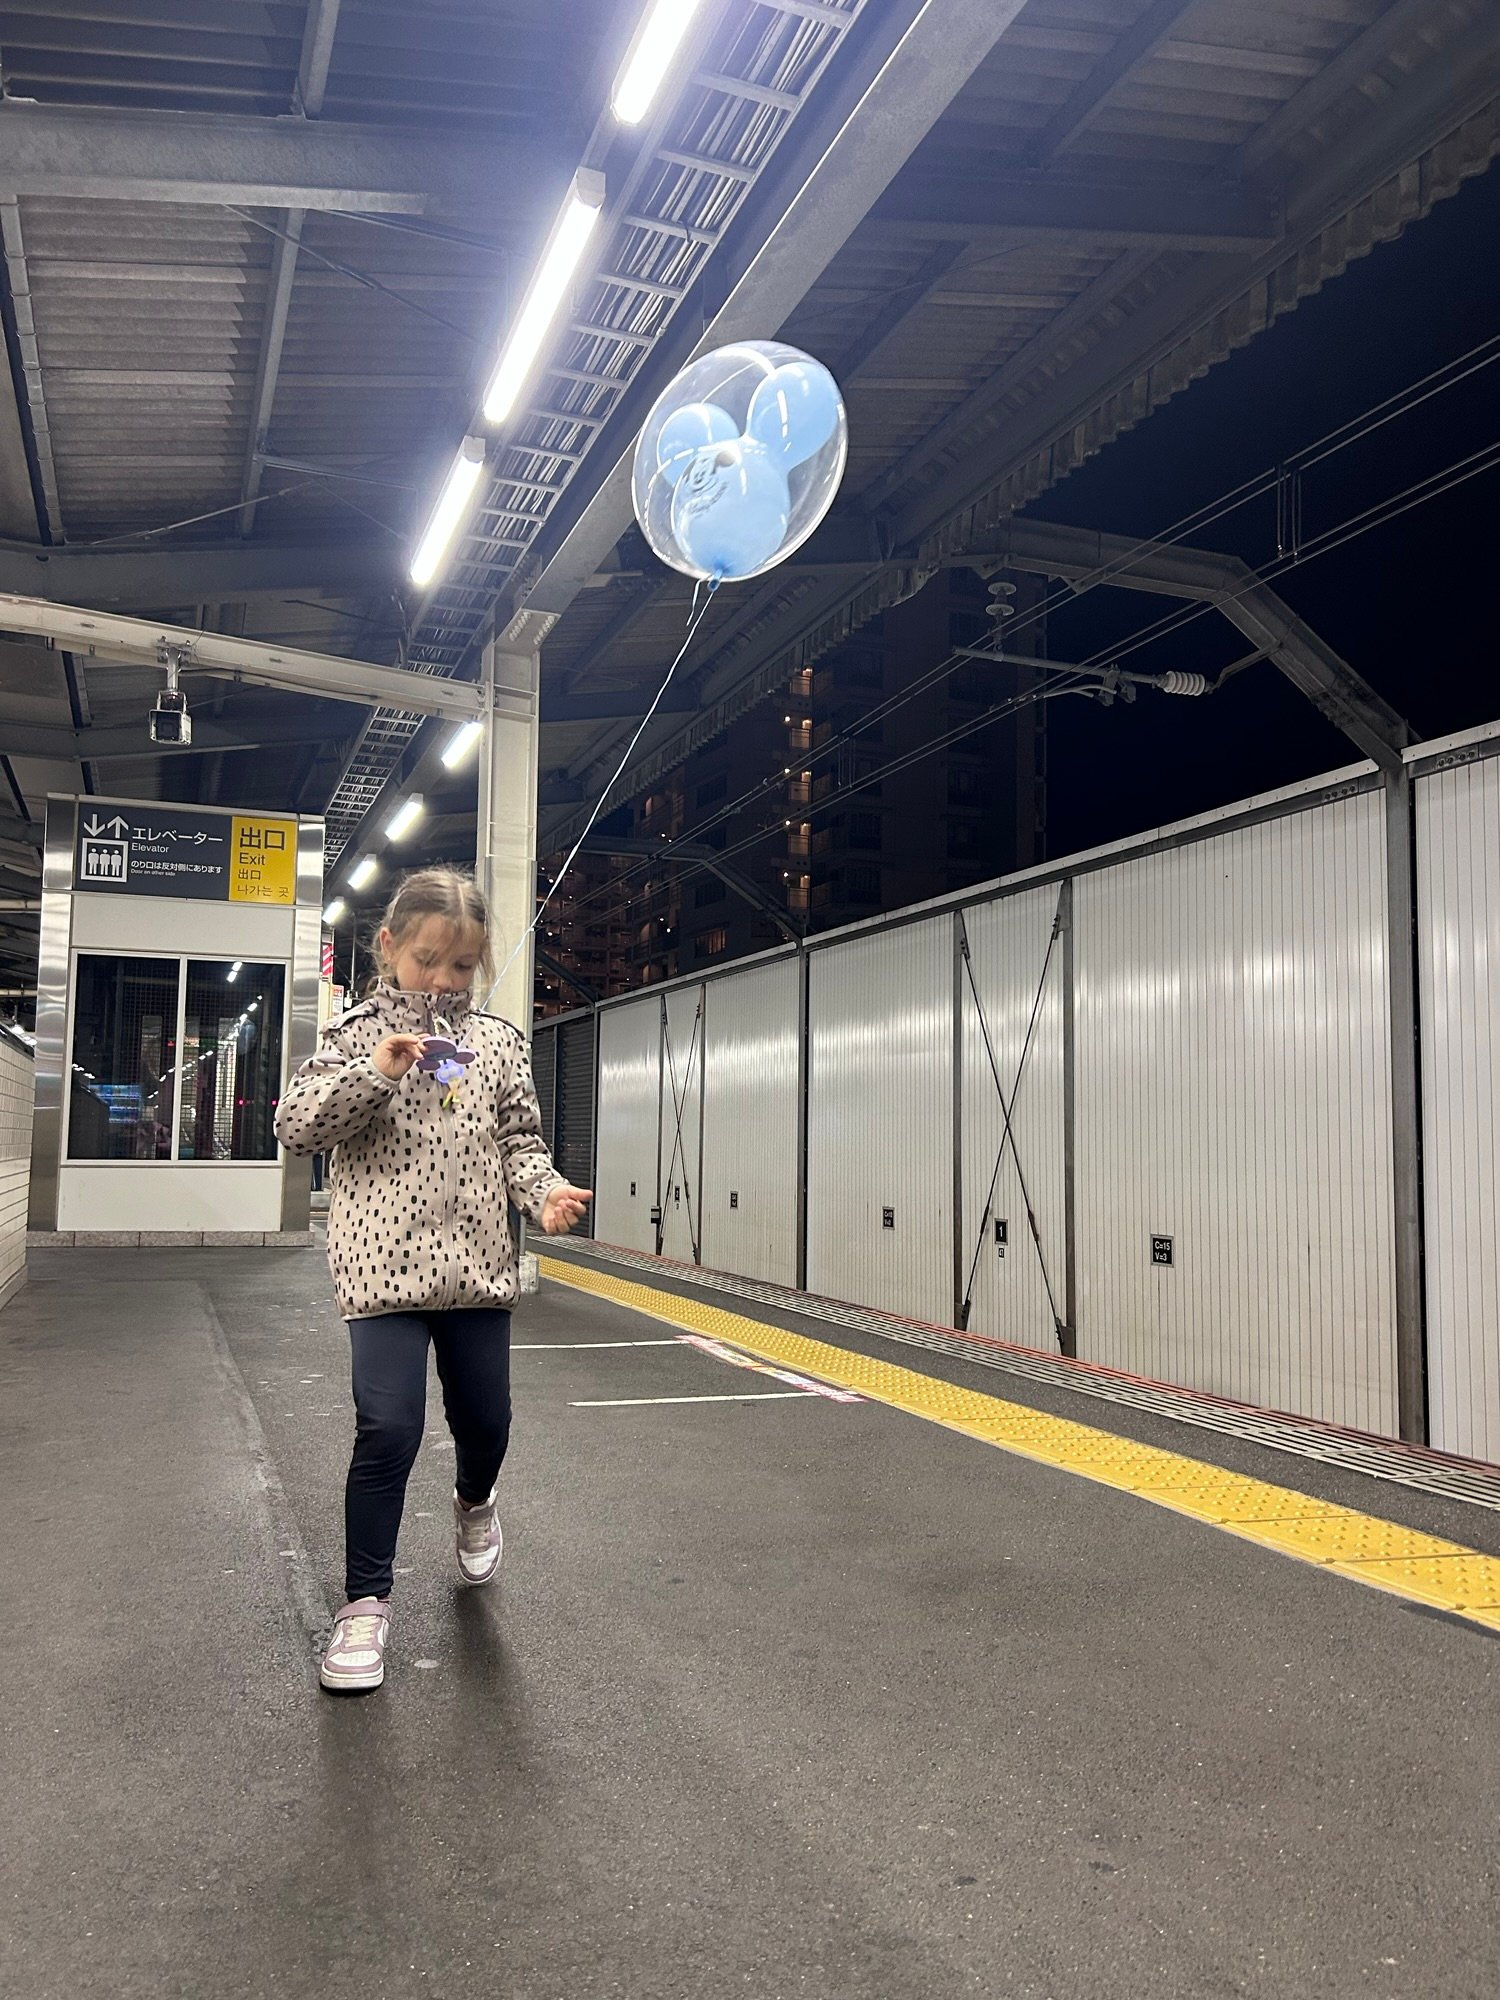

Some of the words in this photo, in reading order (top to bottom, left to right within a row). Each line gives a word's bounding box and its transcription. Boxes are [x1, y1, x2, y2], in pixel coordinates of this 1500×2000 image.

[132, 827, 223, 845] エレベーター
[240, 826, 285, 851] 出口
[131, 842, 170, 853] Elevator
[239, 852, 266, 866] Exit
[130, 860, 223, 874] のり口は反対側にあります
[238, 868, 261, 881] 出口
[237, 884, 273, 897] 나가는
[278, 886, 289, 898] 곳
[1154, 1240, 1171, 1251] C=15
[1155, 1251, 1168, 1261] V=3
